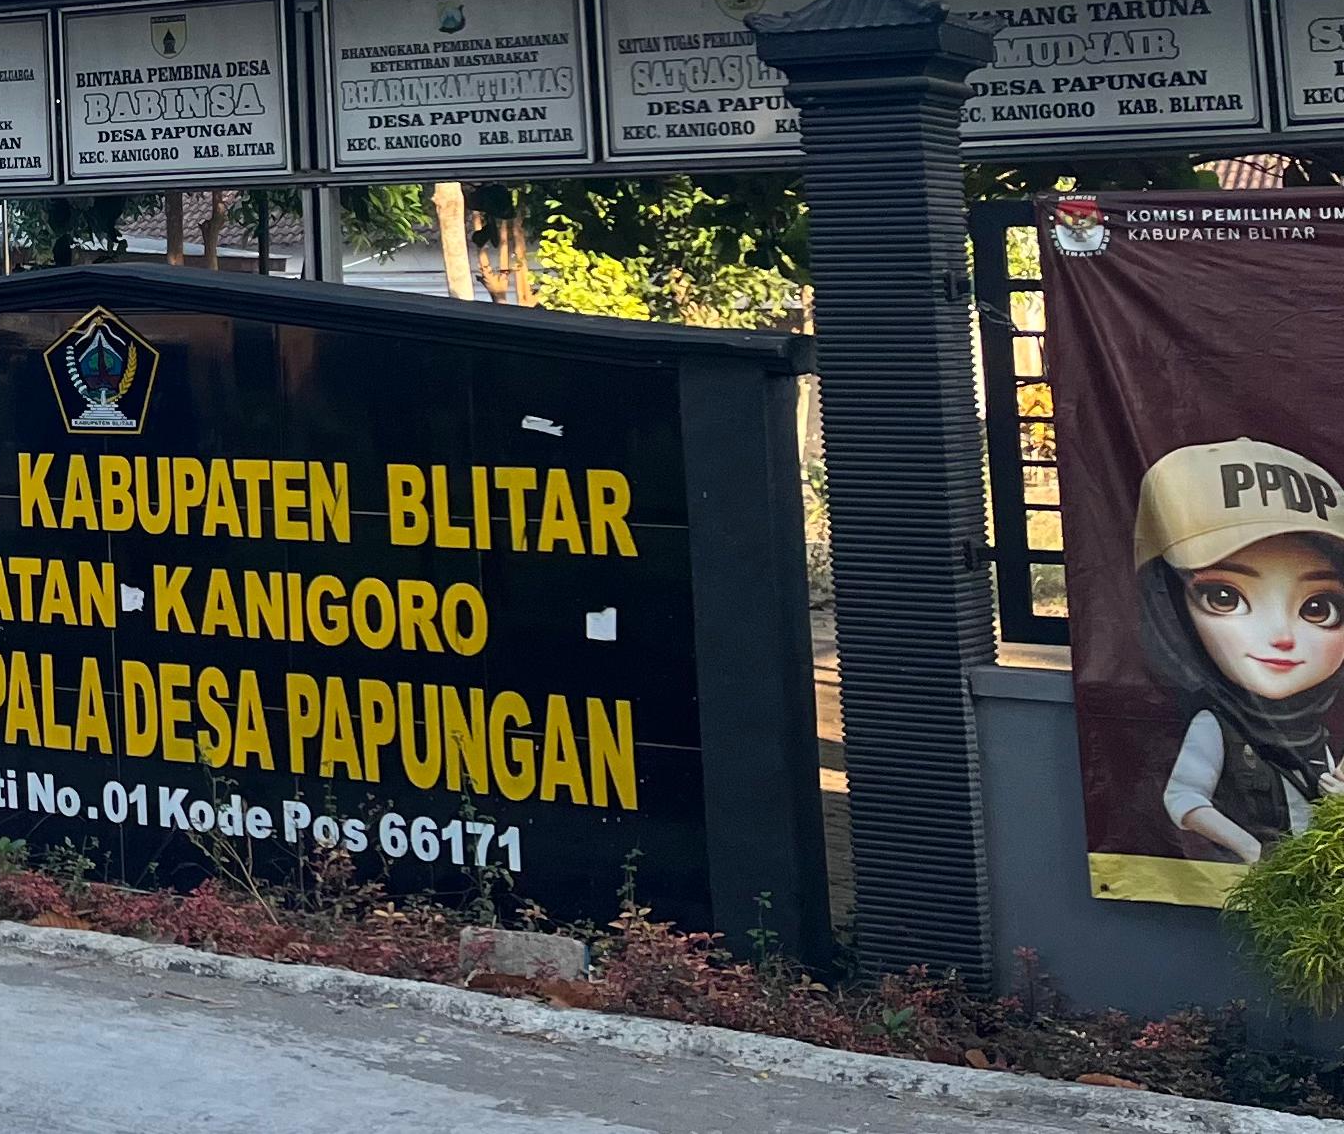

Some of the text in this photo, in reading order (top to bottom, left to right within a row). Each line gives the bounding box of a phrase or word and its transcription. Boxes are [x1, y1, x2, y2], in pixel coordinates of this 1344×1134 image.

[341, 33, 569, 60] BHAYANGKARA PEMBINA KEAMANAN
[618, 37, 660, 54] SATUAN
[663, 34, 701, 51] TUGAS
[993, 28, 1180, 69] MUDJAIR
[76, 59, 270, 88] BINTARA PEMBINA DESA
[370, 51, 539, 73] KETERTIBAN MASYARAKAT
[631, 55, 743, 96] SATGAS
[341, 67, 574, 111] BHABINKAMTIBMAS
[970, 70, 1207, 98] DESA PAPUNGAN
[84, 83, 265, 125] BABINSA
[368, 106, 548, 129] DESA PAPUNGAN
[647, 99, 711, 116] DESA
[992, 94, 1243, 122] KANIGORO KAB. BLITAR
[98, 122, 252, 143] DESA PAPUNGAN
[347, 128, 573, 152] KEC. KANIGORO KAB. BLITAR
[623, 120, 755, 140] KEC. KANIGORO
[0, 156, 42, 170] BLITAR
[79, 142, 275, 164] KEC. KANIGORO KAB. BLITAR
[1126, 209, 1194, 223] KOMISI
[1201, 207, 1311, 222] PEMILIHAN
[1128, 226, 1315, 241] KABUPATEN BLITAR
[18, 452, 351, 544] KABUPATEN
[386, 463, 639, 557] BLITAR
[1220, 462, 1338, 522] PPDP
[153, 564, 489, 657] KANIGORO
[121, 659, 275, 770] DESA
[286, 672, 639, 811] PAPUNGAN
[158, 784, 274, 840] Kode
[283, 798, 369, 853] Pos
[379, 811, 523, 873] 66171
